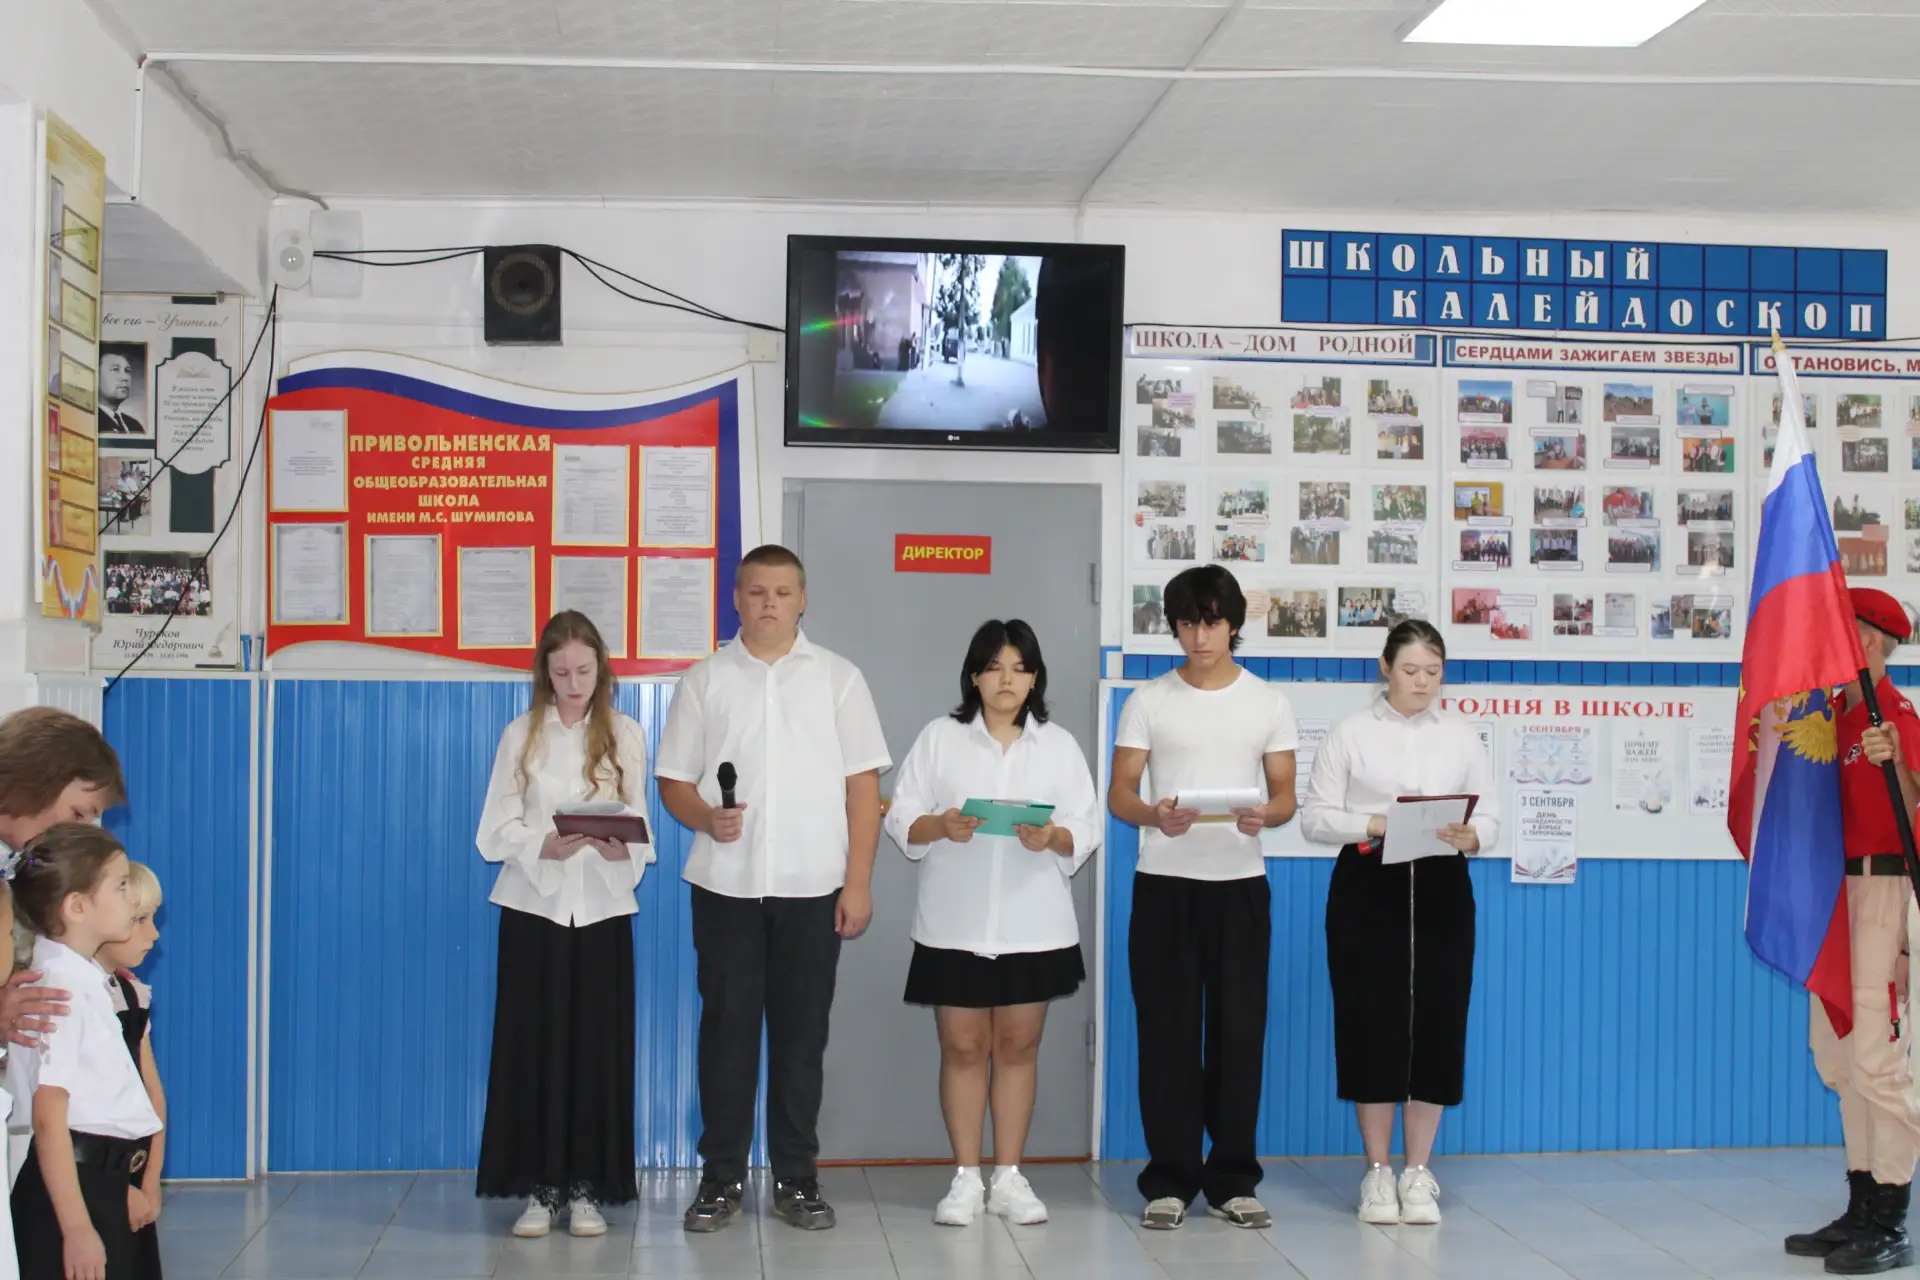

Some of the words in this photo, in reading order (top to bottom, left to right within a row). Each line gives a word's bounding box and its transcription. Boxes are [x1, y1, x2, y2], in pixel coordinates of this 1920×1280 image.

[1289, 240, 1650, 281] ШКОЛЬНЫЙ
[1392, 290, 1872, 332] КАЛЕЙДОСКОП
[158, 311, 229, 331] Учитель!
[1135, 331, 1224, 349] ШКОЛА
[1243, 333, 1297, 354] ДОМ
[1318, 332, 1414, 355] РОДНОЙ
[1456, 345, 1553, 361] СЕРДЦАМИ
[1559, 348, 1656, 363] ЗАЖИГАЕМ
[1664, 350, 1734, 366] ЗВЕЗДЫ
[1763, 355, 1901, 373] ОТАНОВИСЬ,
[349, 434, 551, 452] ПРИВОЛЬНЕНСКАЯ
[411, 456, 487, 471] СРЕДНЯЯ
[353, 475, 548, 490] ОБЩЕОБРАЗОВАТЕЛЬНАЯ
[417, 494, 480, 507] ШКОЛА
[367, 512, 415, 523] ИМЕНИ
[418, 511, 448, 523] М.С.
[451, 511, 535, 523] ШУМИЛОВА
[902, 546, 984, 560] ДИРЕКТОР
[135, 628, 180, 640] Чурков
[113, 639, 145, 651] Юрий
[1554, 699, 1571, 716] В
[1582, 700, 1694, 718] ШКОЛЕ
[1529, 725, 1581, 734] СЕНТЯБРЯ
[1521, 796, 1527, 806] 3
[1529, 796, 1574, 808] СЕНТЯБРЯ
